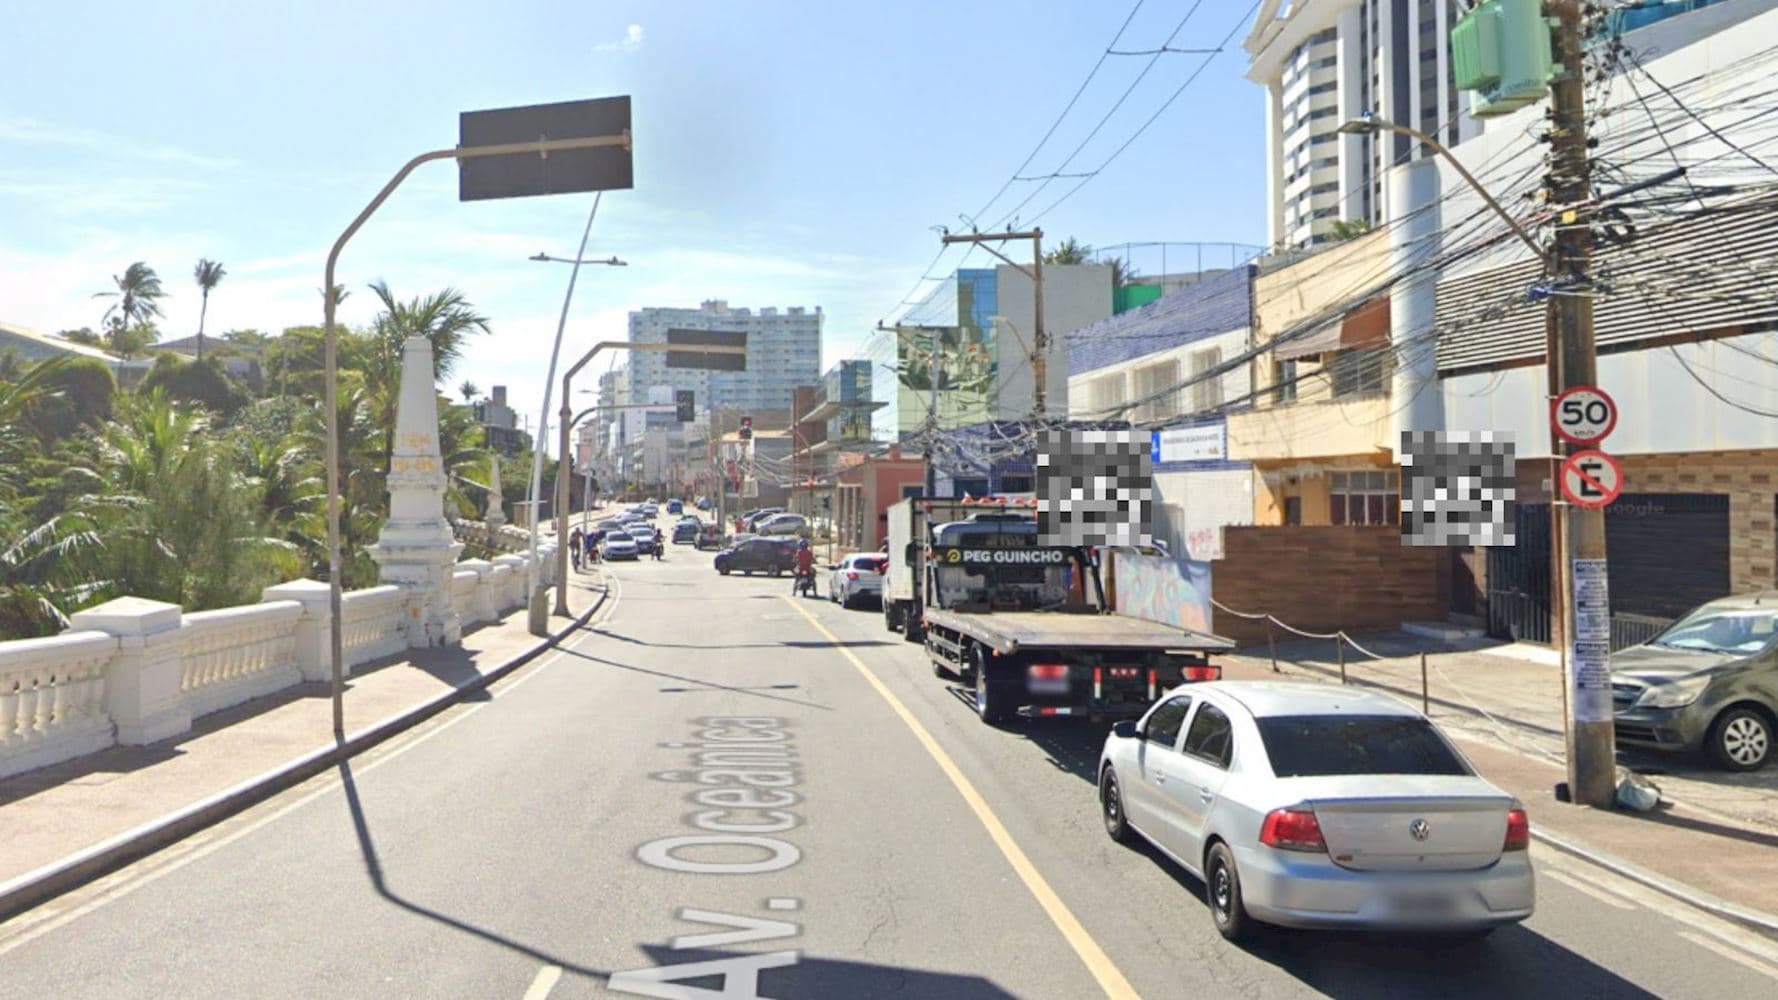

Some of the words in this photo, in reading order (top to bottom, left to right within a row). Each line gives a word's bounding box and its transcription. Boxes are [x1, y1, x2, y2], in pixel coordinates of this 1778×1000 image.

[1562, 400, 1608, 425] 50
[1580, 463, 1602, 497] E
[963, 550, 991, 562] PEG
[994, 550, 1063, 563] GUINCHO
